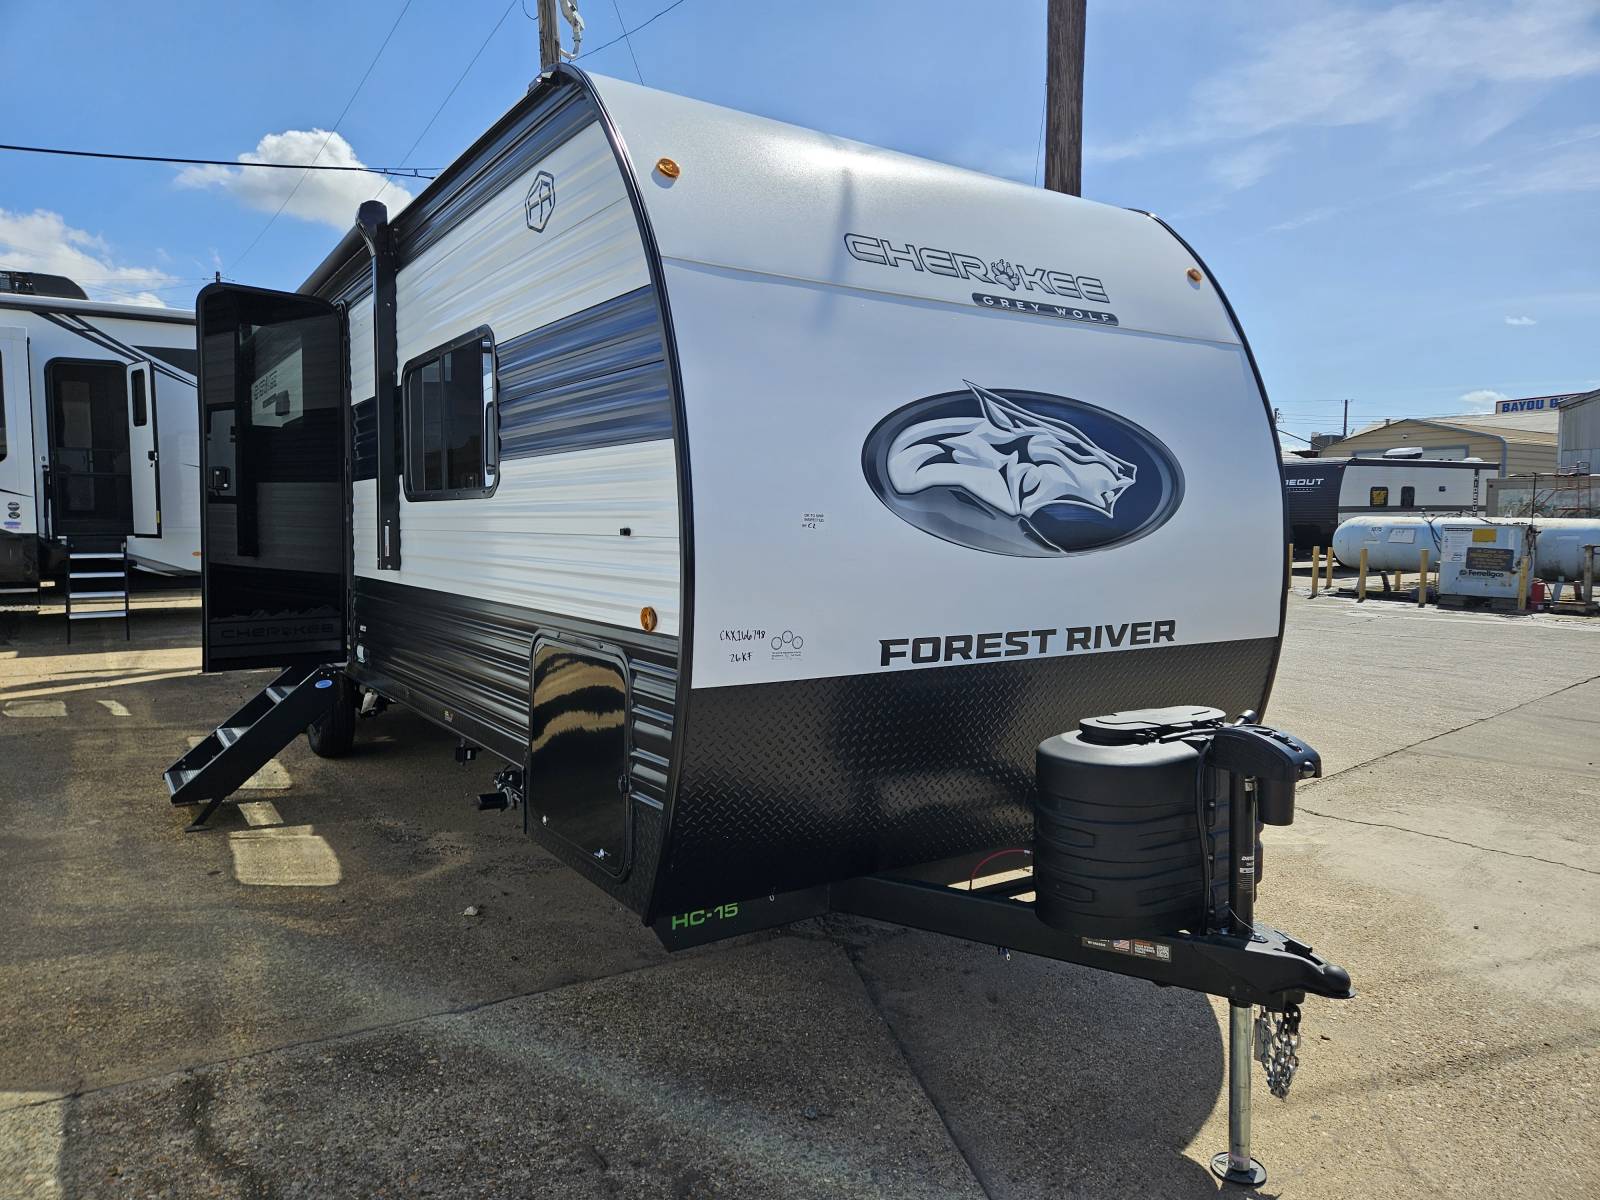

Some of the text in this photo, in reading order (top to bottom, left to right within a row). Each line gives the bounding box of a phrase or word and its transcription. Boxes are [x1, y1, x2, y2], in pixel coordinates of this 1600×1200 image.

[982, 296, 1110, 323] GREY WOLF
[1502, 399, 1545, 412] BAYOU
[878, 619, 1176, 667] FOREST RIVER
[671, 902, 739, 930] HC-15
